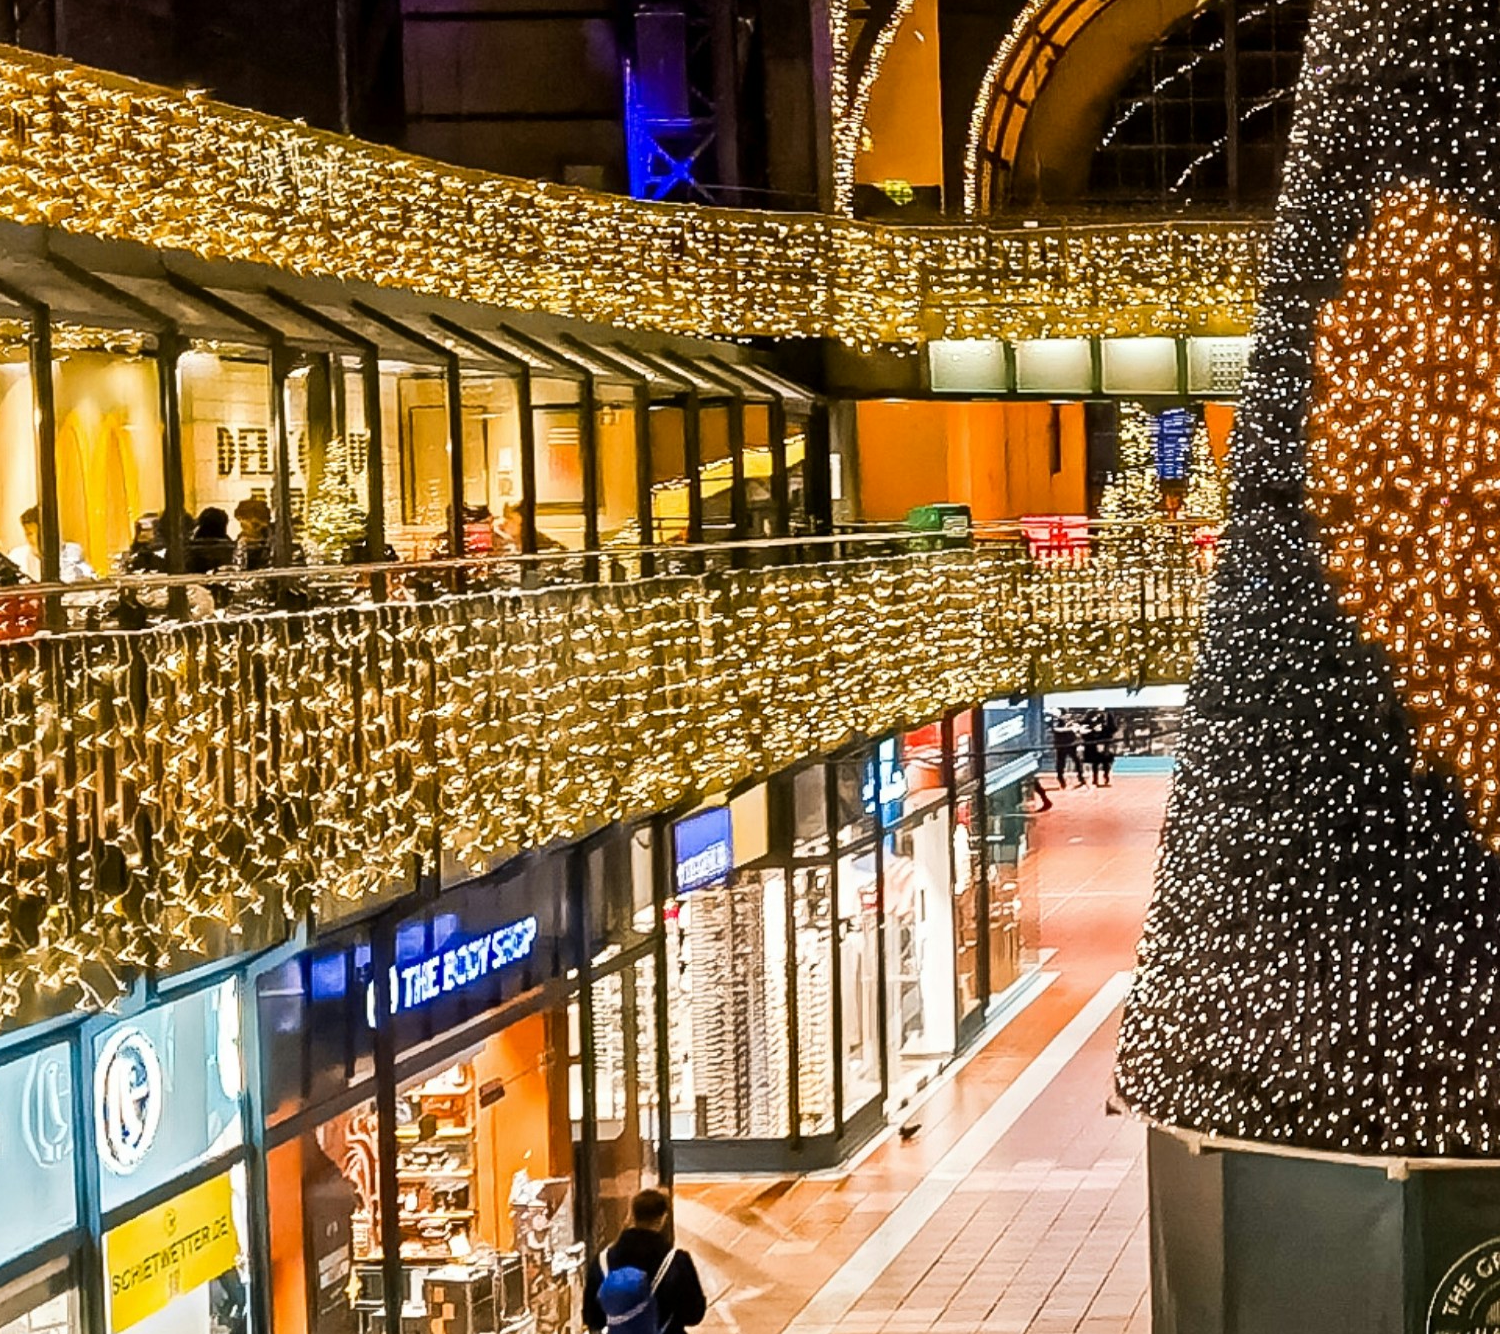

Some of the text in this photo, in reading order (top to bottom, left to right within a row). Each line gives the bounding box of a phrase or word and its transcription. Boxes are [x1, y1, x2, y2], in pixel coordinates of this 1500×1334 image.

[401, 916, 537, 1008] THE BODY SHOP
[1442, 1272, 1477, 1317] THE
